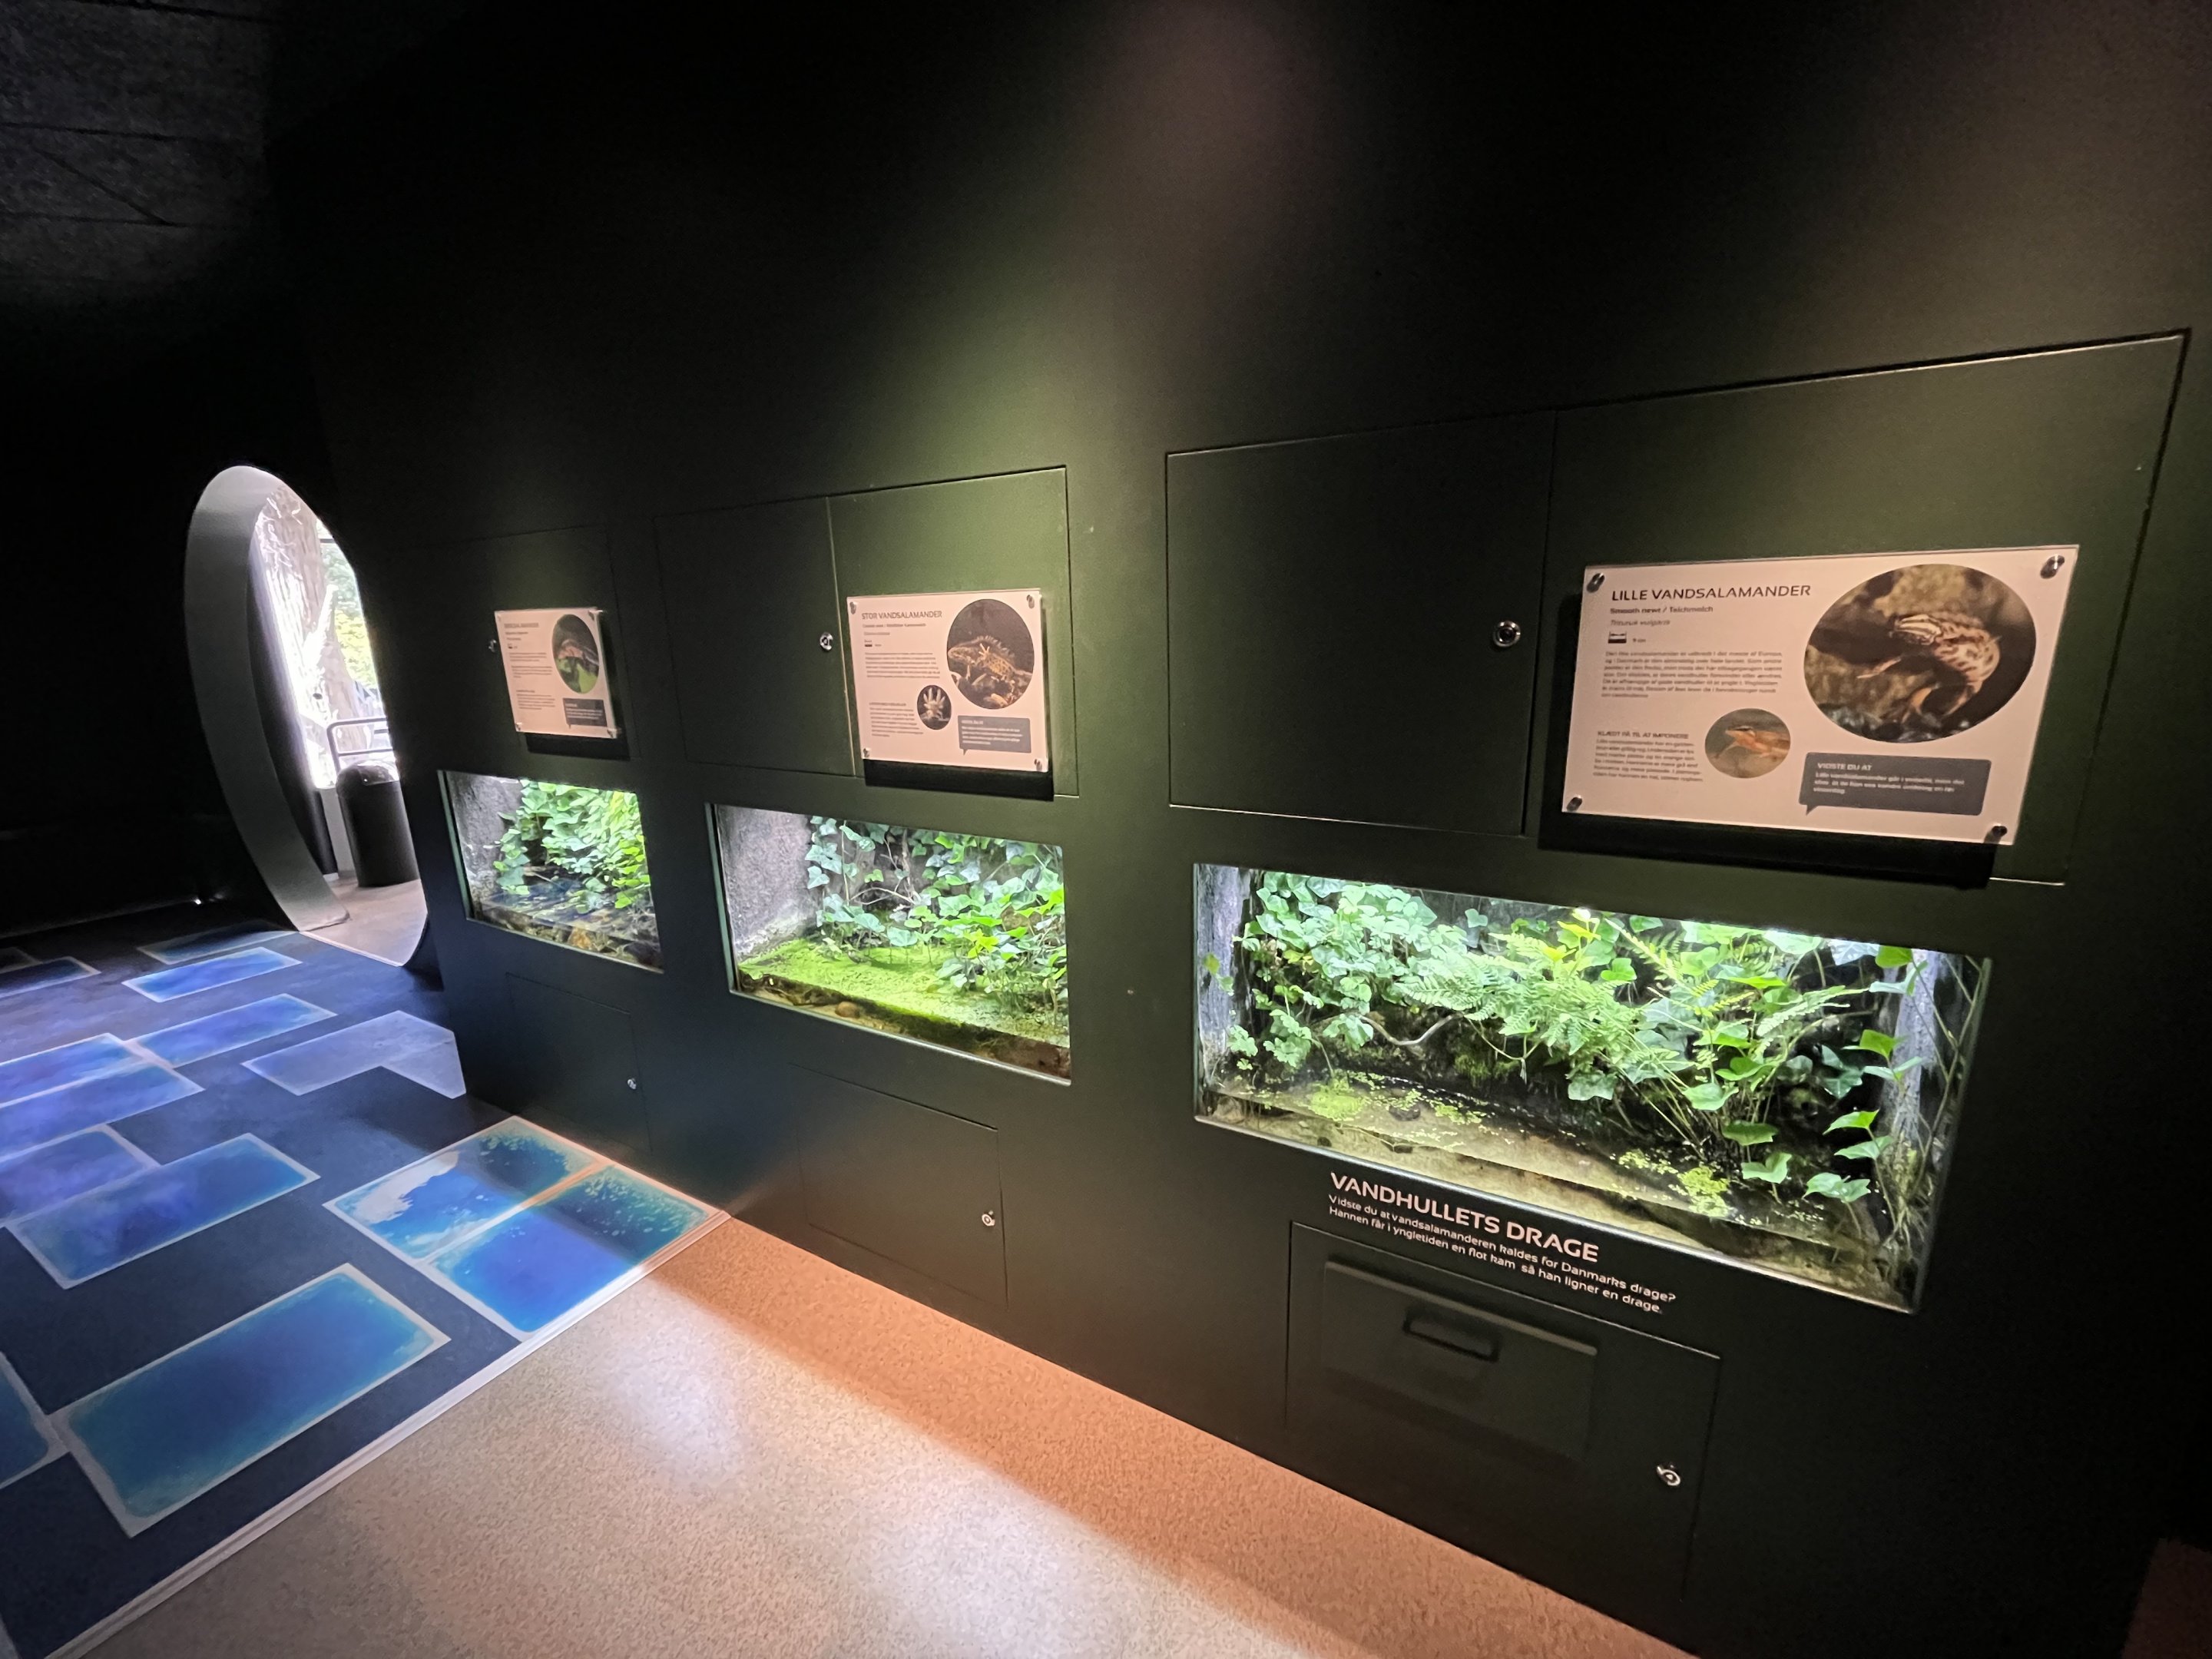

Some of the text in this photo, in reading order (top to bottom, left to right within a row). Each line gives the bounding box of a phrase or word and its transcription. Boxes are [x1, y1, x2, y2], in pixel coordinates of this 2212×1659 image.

[861, 610, 942, 620] STOR VANDSALAMANDER
[1611, 584, 1811, 601] LILLE VANDSALAMANDER
[1328, 1194, 1677, 1303] Vidste du at vandsalamanderen kaldes for Danmarks drage?
[1330, 1172, 1599, 1263] VANDHULLETS DRAGE
[1330, 1206, 1369, 1225] Hannen
[1371, 1218, 1386, 1230] får
[1387, 1221, 1391, 1231] i
[1392, 1226, 1449, 1250] yngletiden
[1452, 1244, 1465, 1254] en
[1469, 1247, 1488, 1261] flot
[1521, 1264, 1535, 1275] så
[1538, 1268, 1561, 1283] han
[1565, 1276, 1599, 1294] ligner
[1602, 1289, 1619, 1300] en
